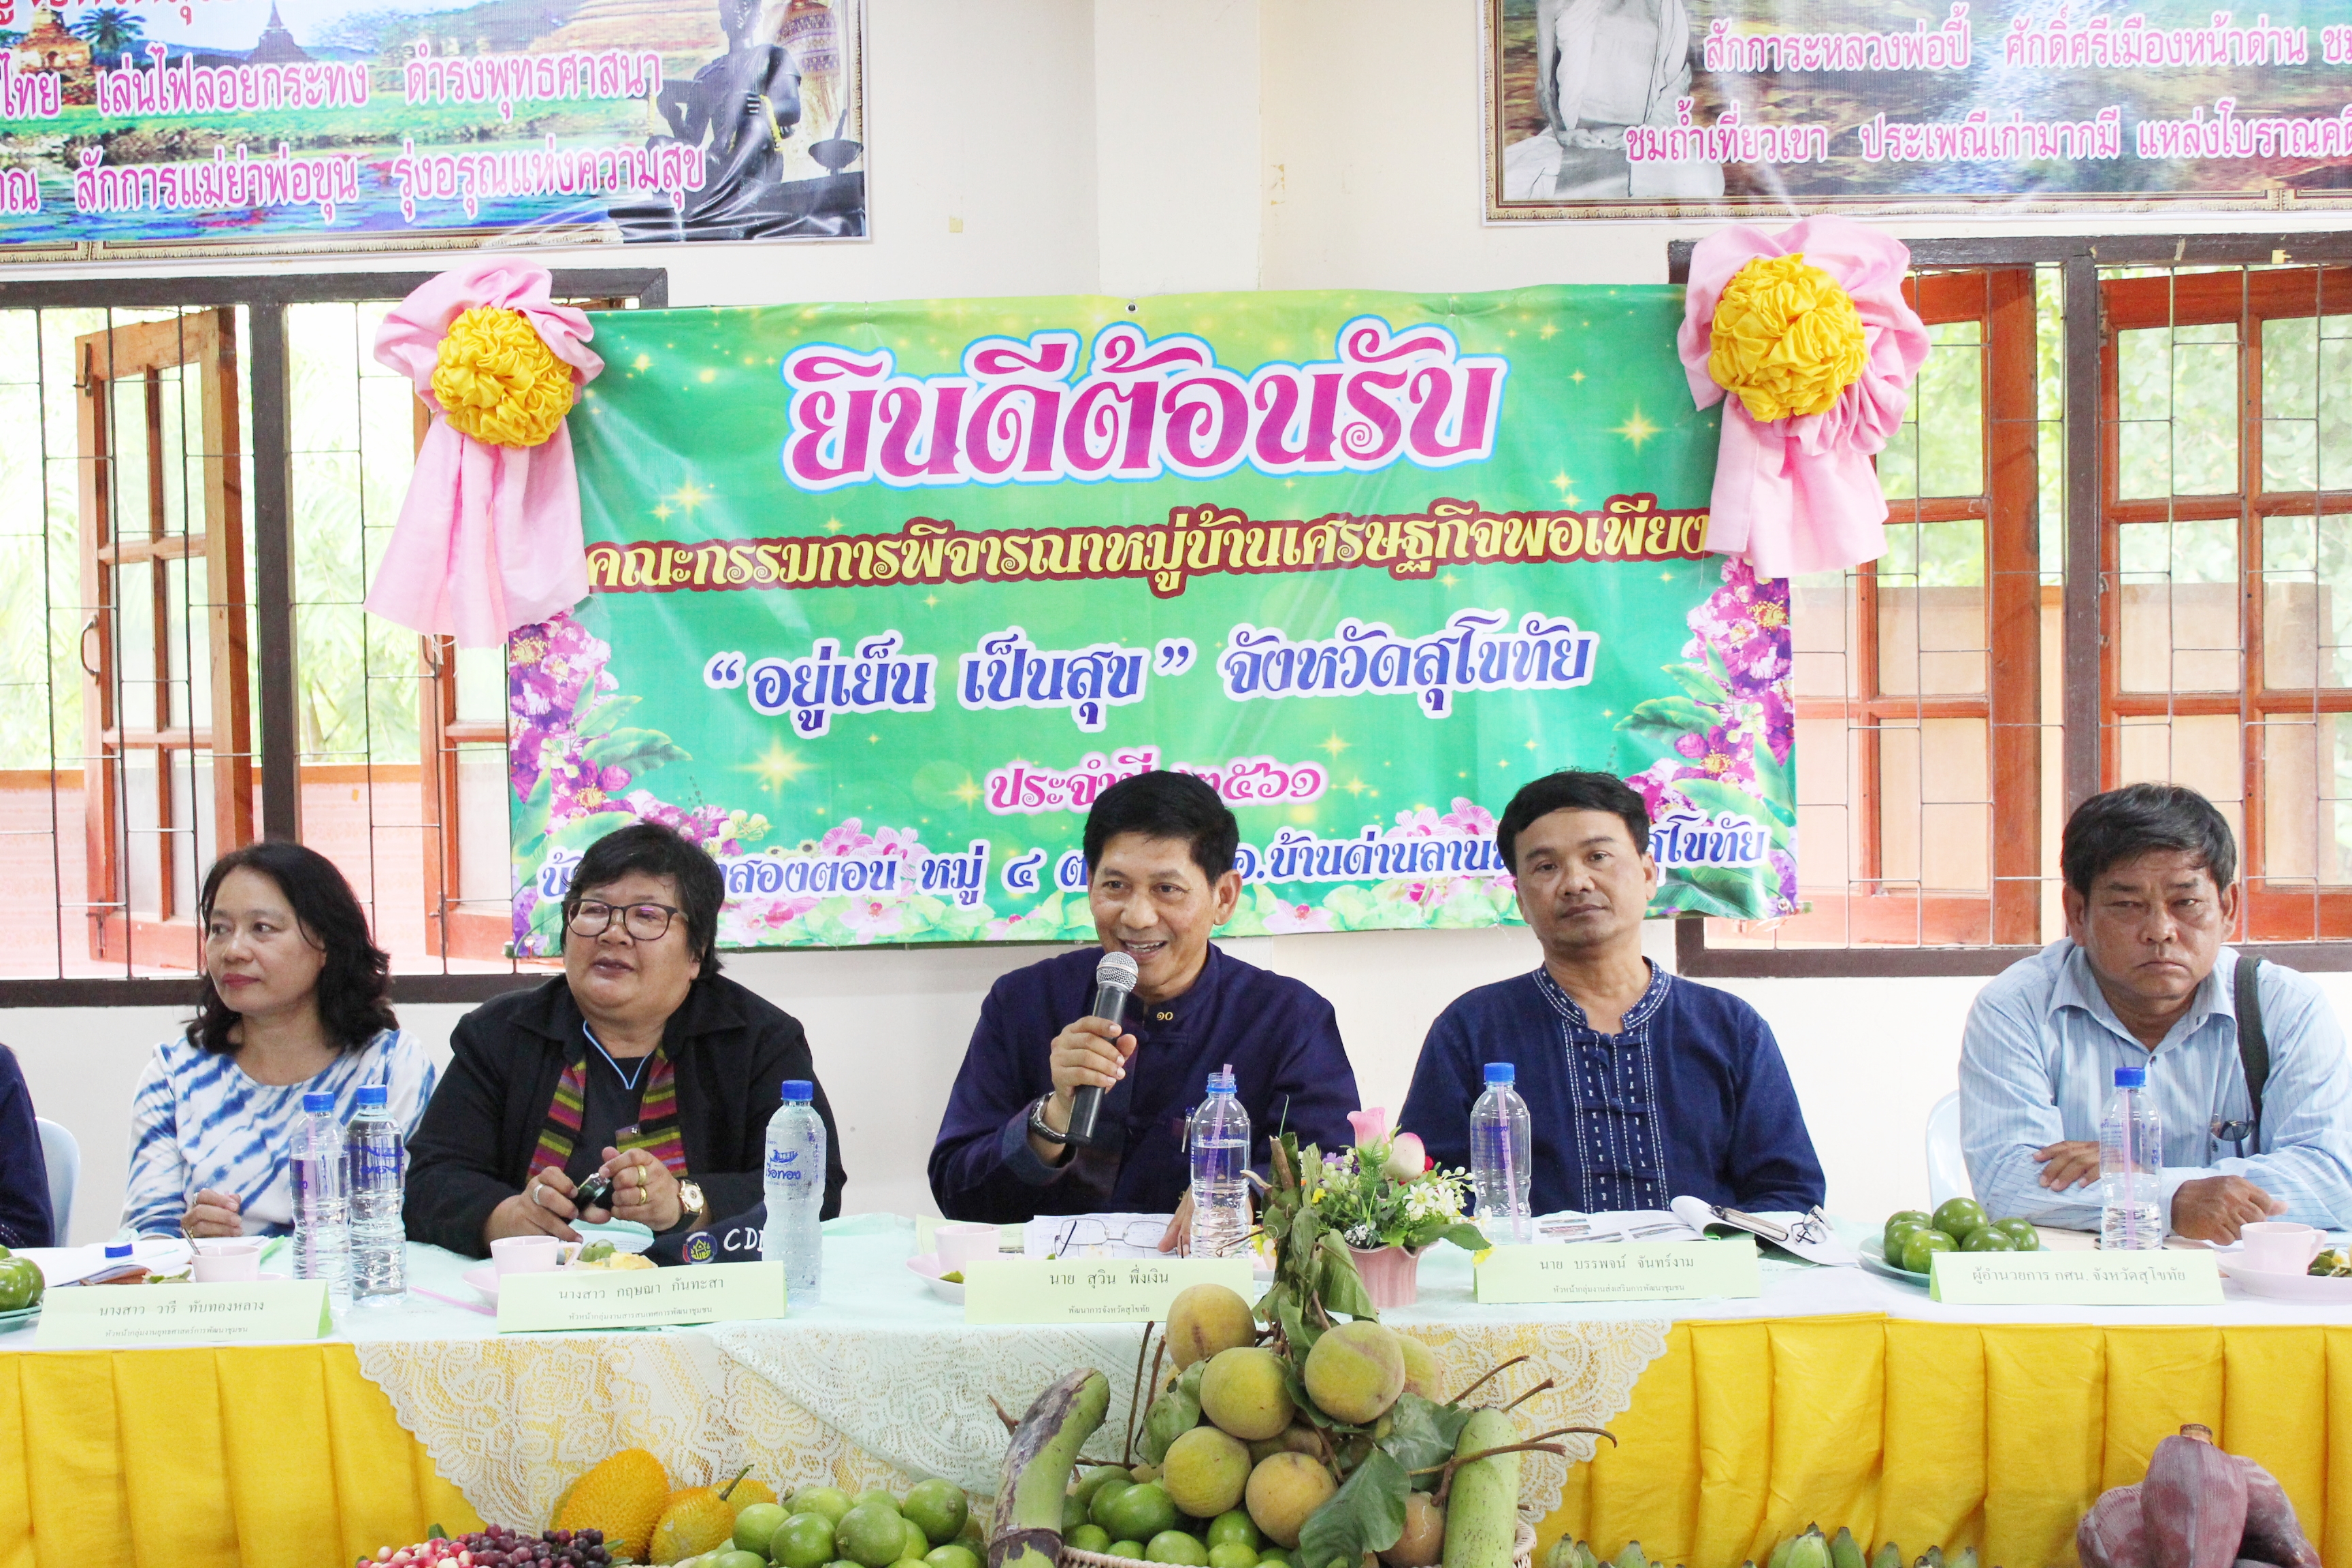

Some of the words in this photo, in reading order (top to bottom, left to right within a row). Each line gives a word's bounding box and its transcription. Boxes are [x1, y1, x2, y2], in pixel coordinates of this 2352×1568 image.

[1705, 5, 1968, 70] สักการะหลวงพ่อปี้
[2006, 7, 2305, 66] ศักดิ์ศรีเมืองหน้าด่าน
[99, 46, 367, 114] เล่นไฟลอยกระทง
[406, 43, 660, 120] ดำรงพุทธศาสนา
[1626, 99, 1827, 161] ชมถ้ำเที่ยวเขา
[1861, 106, 2119, 159] ประเพณีเก่ามากมี
[76, 144, 356, 220] สักการแม่ย่าพ่อขุน
[394, 135, 705, 220] รุ่งอรุณแห่งความสุข
[791, 327, 1497, 480] ยินดีต้อนรับ
[1224, 615, 1592, 711] จังหวัดสุโขทัย
[992, 753, 1154, 808] ประจำี
[921, 845, 985, 905] หมู่
[559, 1288, 606, 1300] นางสาว
[1049, 1274, 1075, 1286] นาย
[1539, 1260, 1563, 1270] นาย
[1972, 1266, 2049, 1285] ผู้อำนวยการ
[2093, 1267, 2186, 1285] จังหวัดสุโขทัย
[99, 1305, 146, 1317] นางสาว
